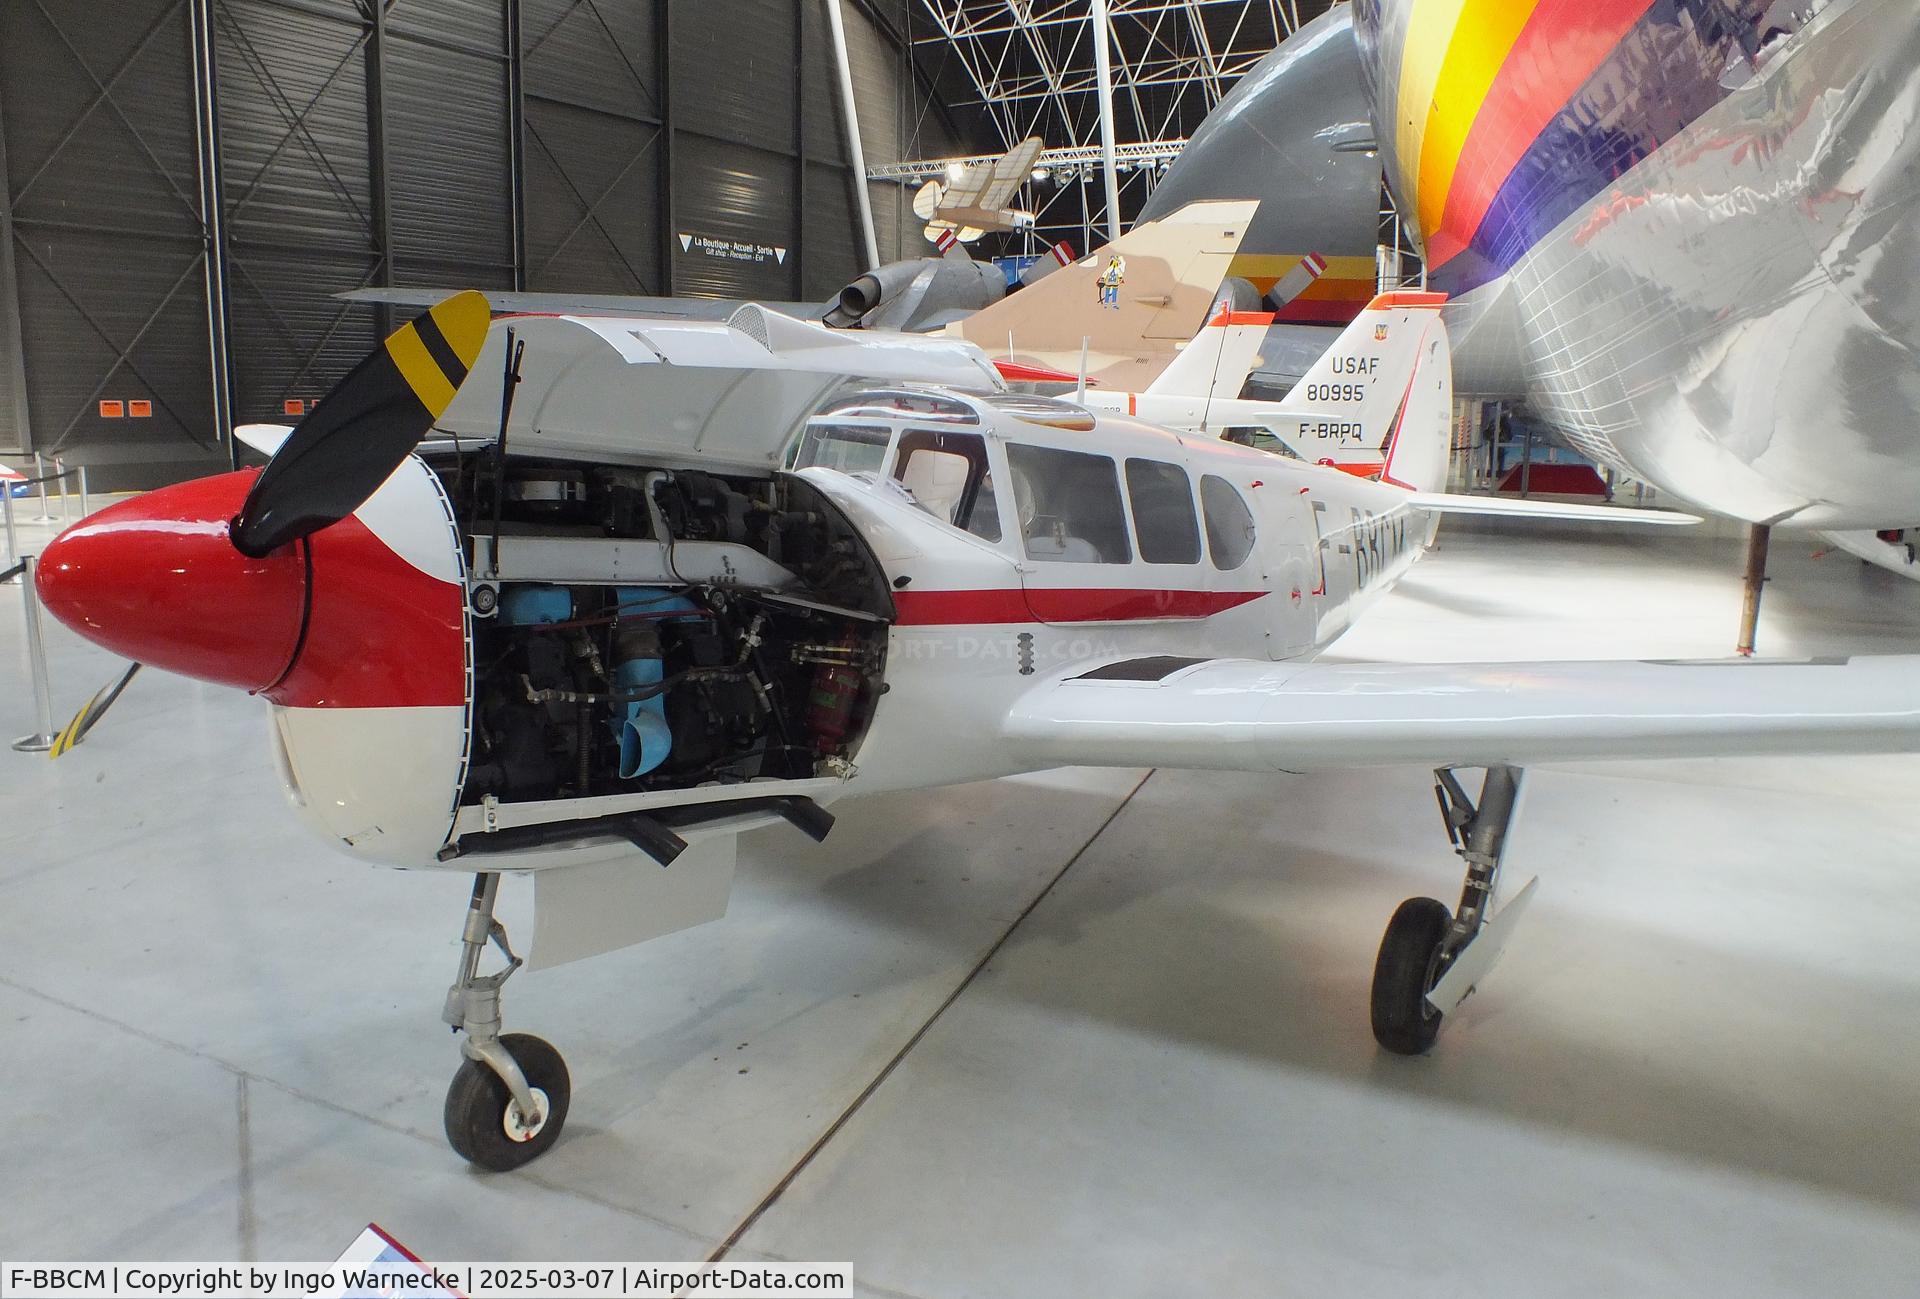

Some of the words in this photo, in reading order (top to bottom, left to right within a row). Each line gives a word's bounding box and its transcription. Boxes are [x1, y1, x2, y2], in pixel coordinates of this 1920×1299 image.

[694, 236, 702, 246] La
[703, 238, 730, 250] Boutique
[733, 242, 753, 253] Accueil
[757, 245, 774, 256] Sortie
[1332, 357, 1380, 375] USAF
[1307, 384, 1365, 402] 80995
[1299, 423, 1363, 442] F-BRPQ
